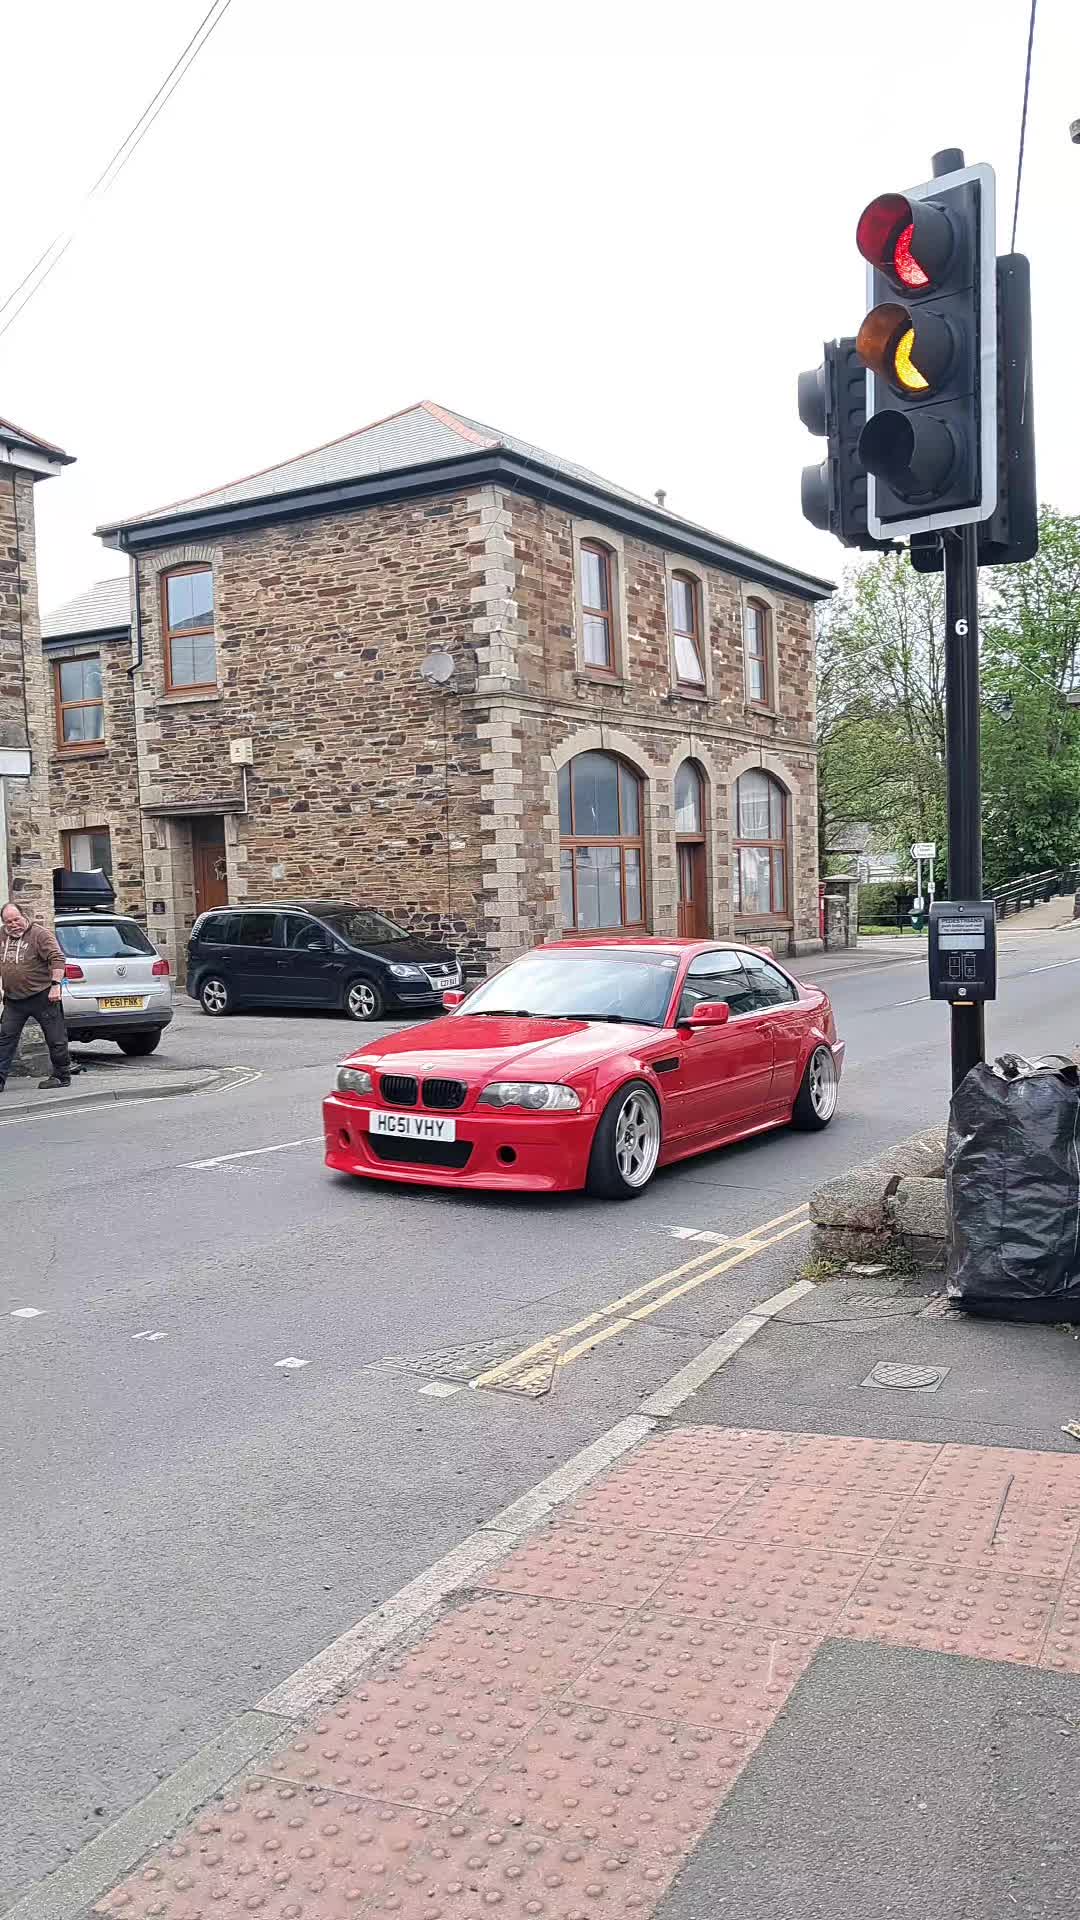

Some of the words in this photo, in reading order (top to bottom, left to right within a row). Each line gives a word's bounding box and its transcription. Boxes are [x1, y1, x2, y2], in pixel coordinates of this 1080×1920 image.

[955, 618, 968, 636] 6
[378, 1114, 410, 1134] HG51
[415, 1118, 445, 1137] VHY
